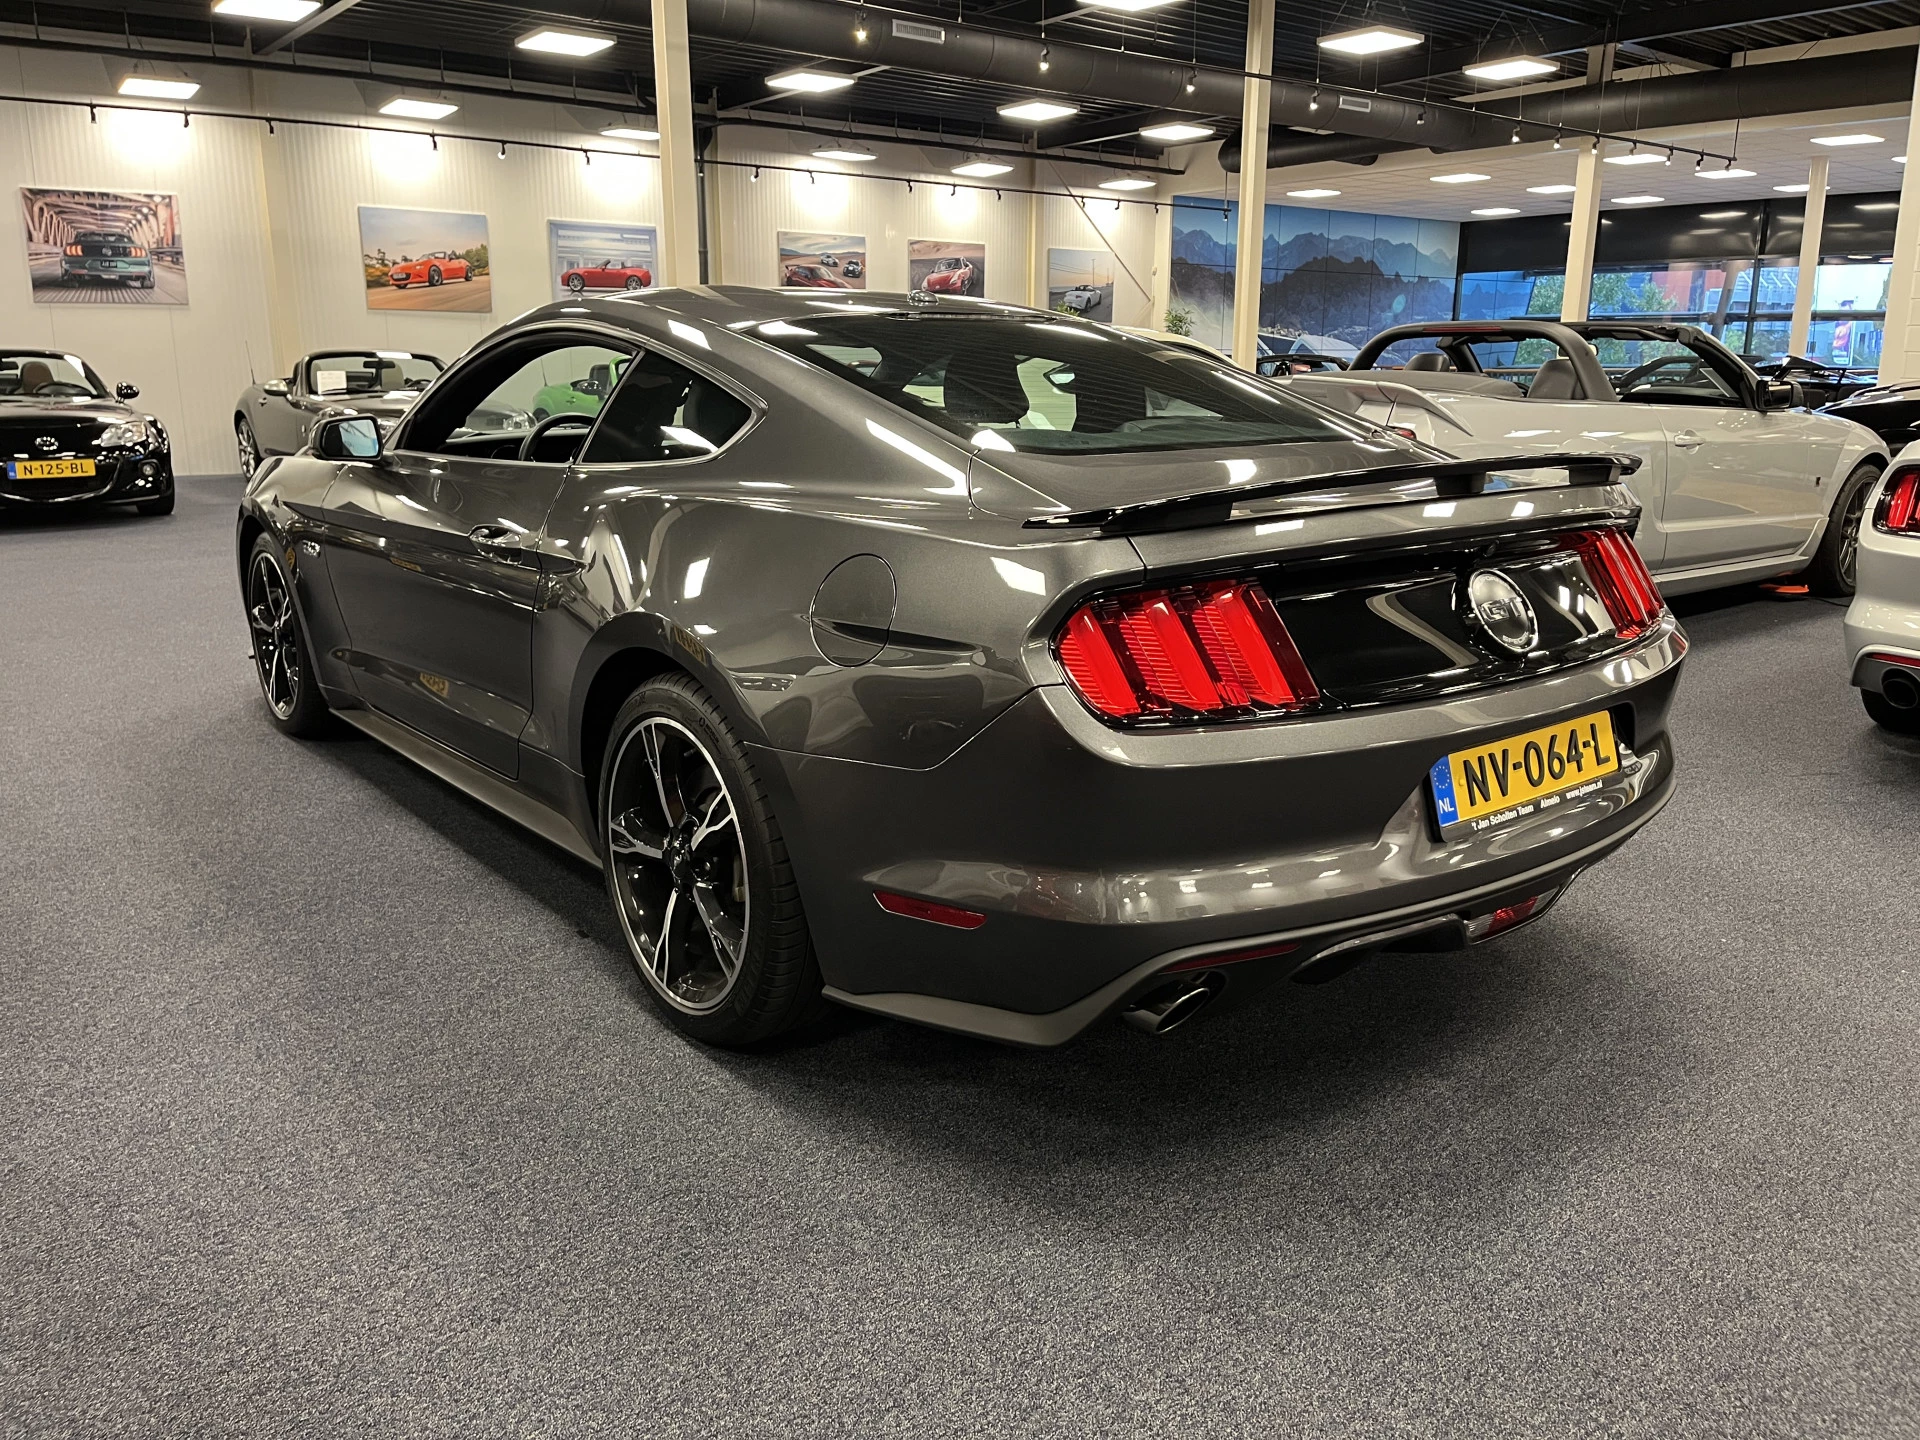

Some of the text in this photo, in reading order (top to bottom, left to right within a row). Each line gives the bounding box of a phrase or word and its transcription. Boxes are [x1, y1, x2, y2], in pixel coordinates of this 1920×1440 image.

[23, 462, 89, 476] N-125-BL
[1480, 597, 1522, 622] GT
[1463, 723, 1610, 807] NV-064-L
[1438, 797, 1455, 814] NL
[1477, 819, 1490, 830] Jan
[1490, 810, 1517, 825] Scholten
[1517, 804, 1535, 816] Team
